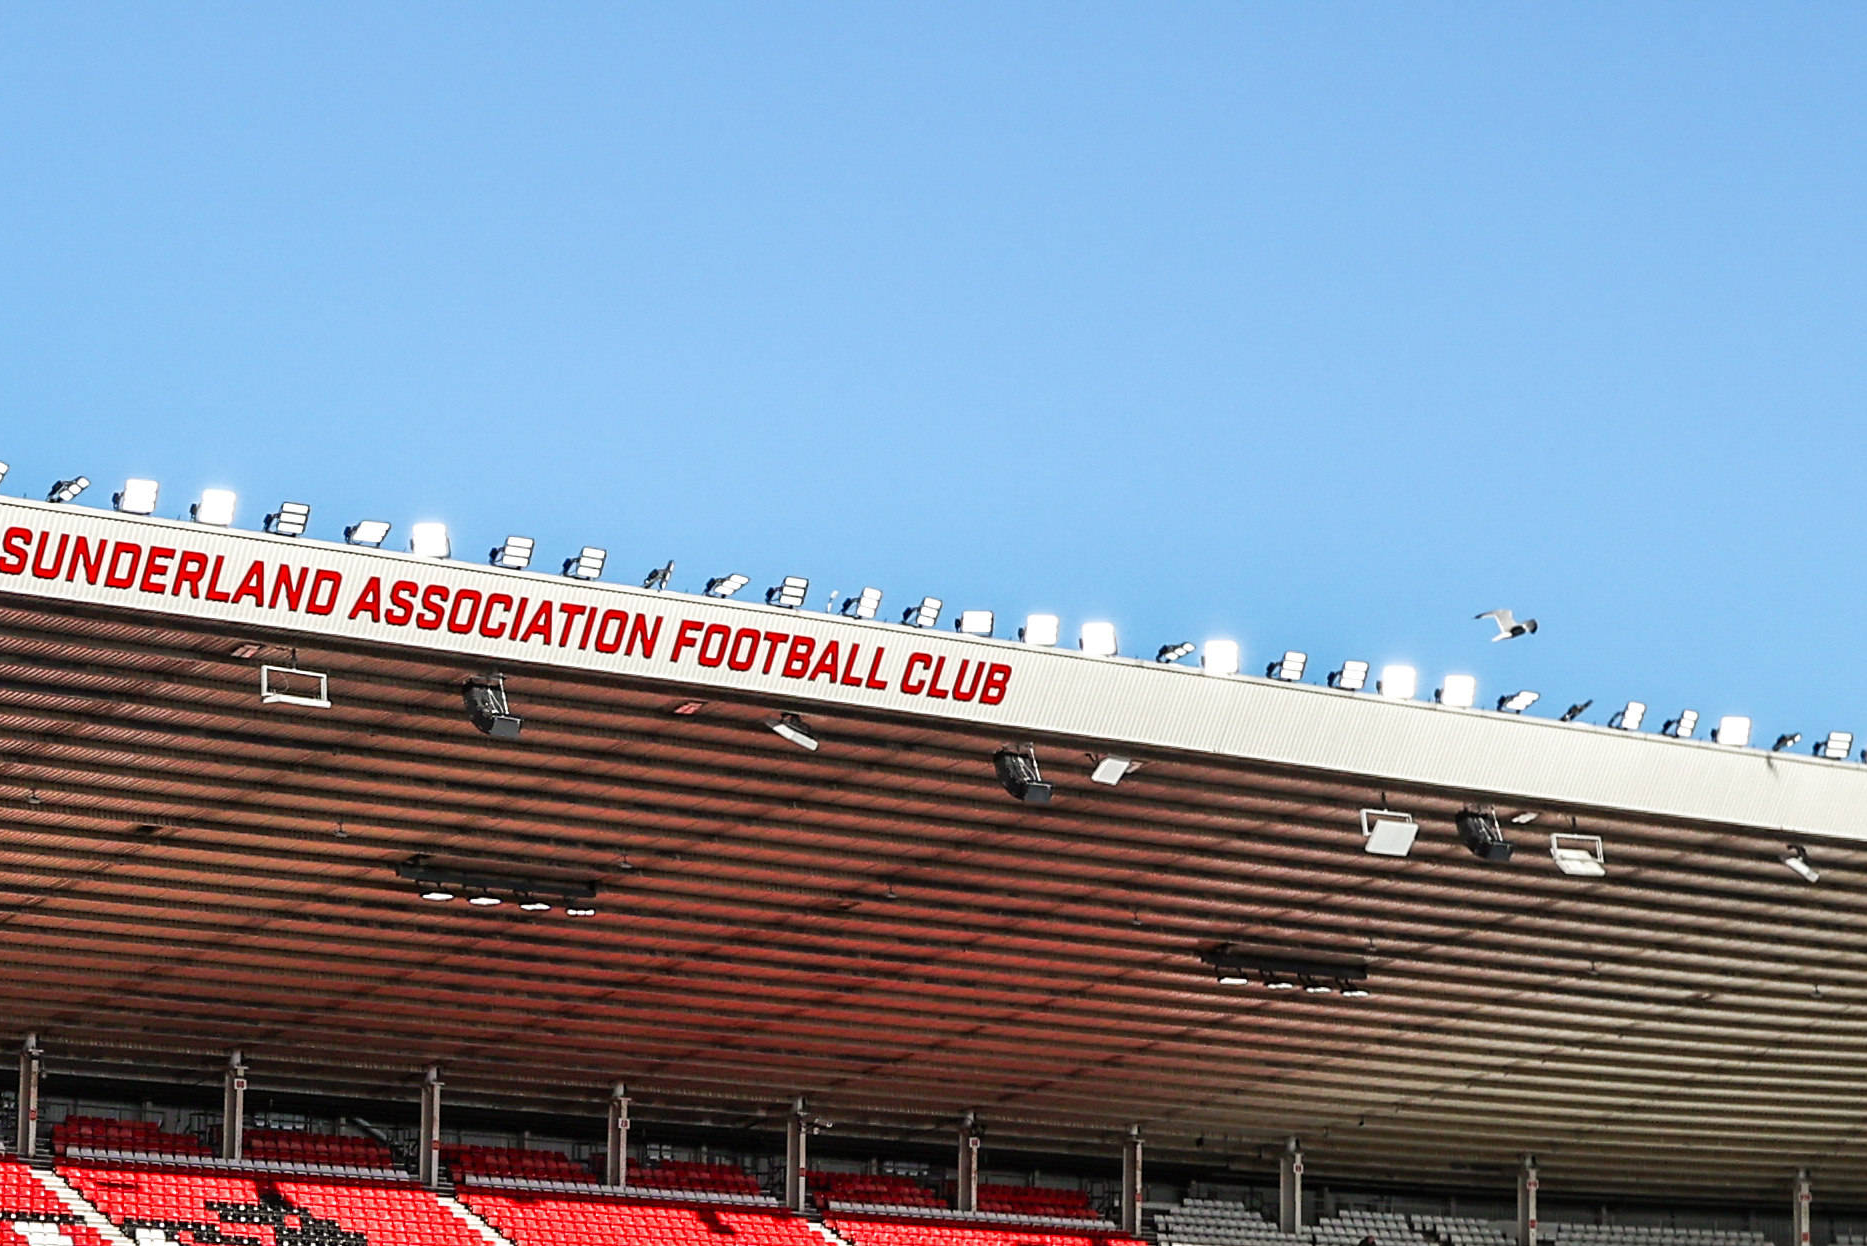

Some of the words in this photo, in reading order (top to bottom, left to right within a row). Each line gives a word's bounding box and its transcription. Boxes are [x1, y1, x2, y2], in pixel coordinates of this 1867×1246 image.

[0, 527, 342, 613] SUNDERLAND
[350, 577, 663, 656] ASSOCIATION
[673, 620, 887, 688] FOOTBALL
[902, 652, 1011, 704] CLUB
